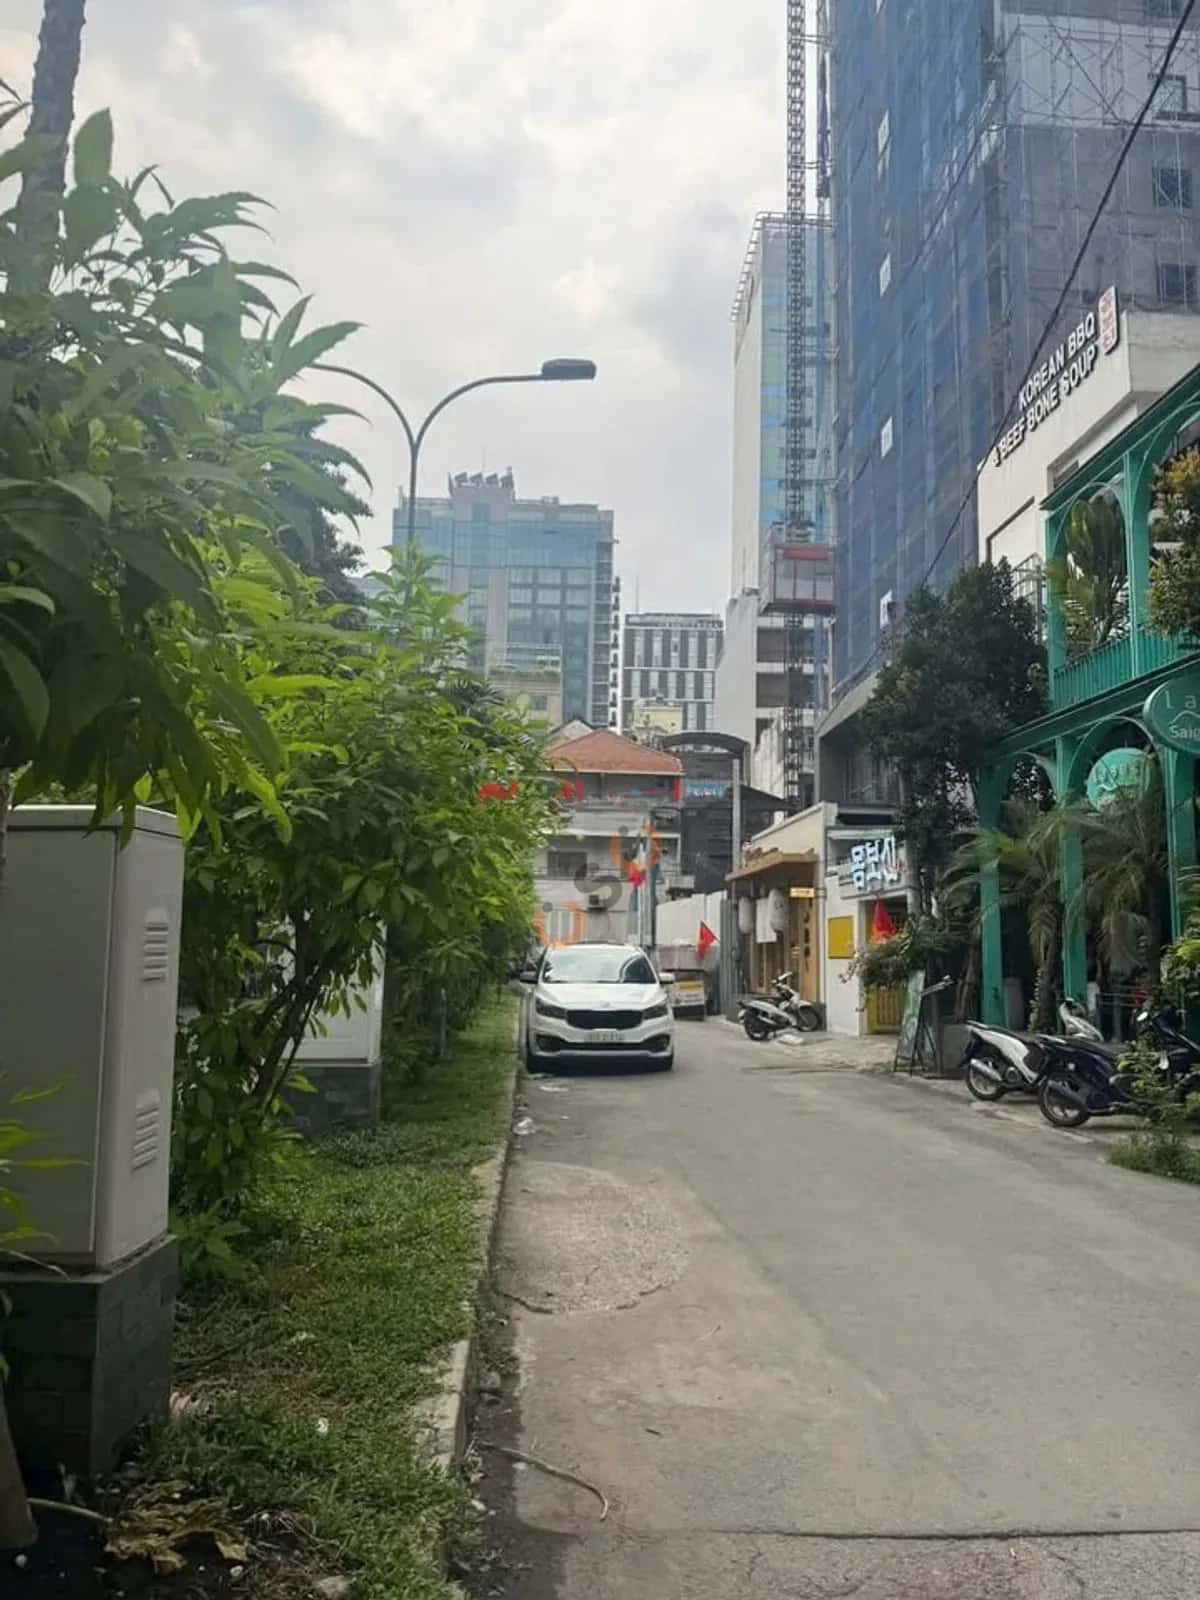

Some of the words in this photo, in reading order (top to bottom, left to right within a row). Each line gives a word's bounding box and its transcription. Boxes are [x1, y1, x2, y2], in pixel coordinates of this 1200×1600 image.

[998, 416, 1025, 455] BEEF
[1026, 384, 1058, 431] BONE
[1059, 345, 1096, 395] SOUP
[1019, 345, 1064, 411] KOREAN
[1068, 312, 1095, 357] BBQ
